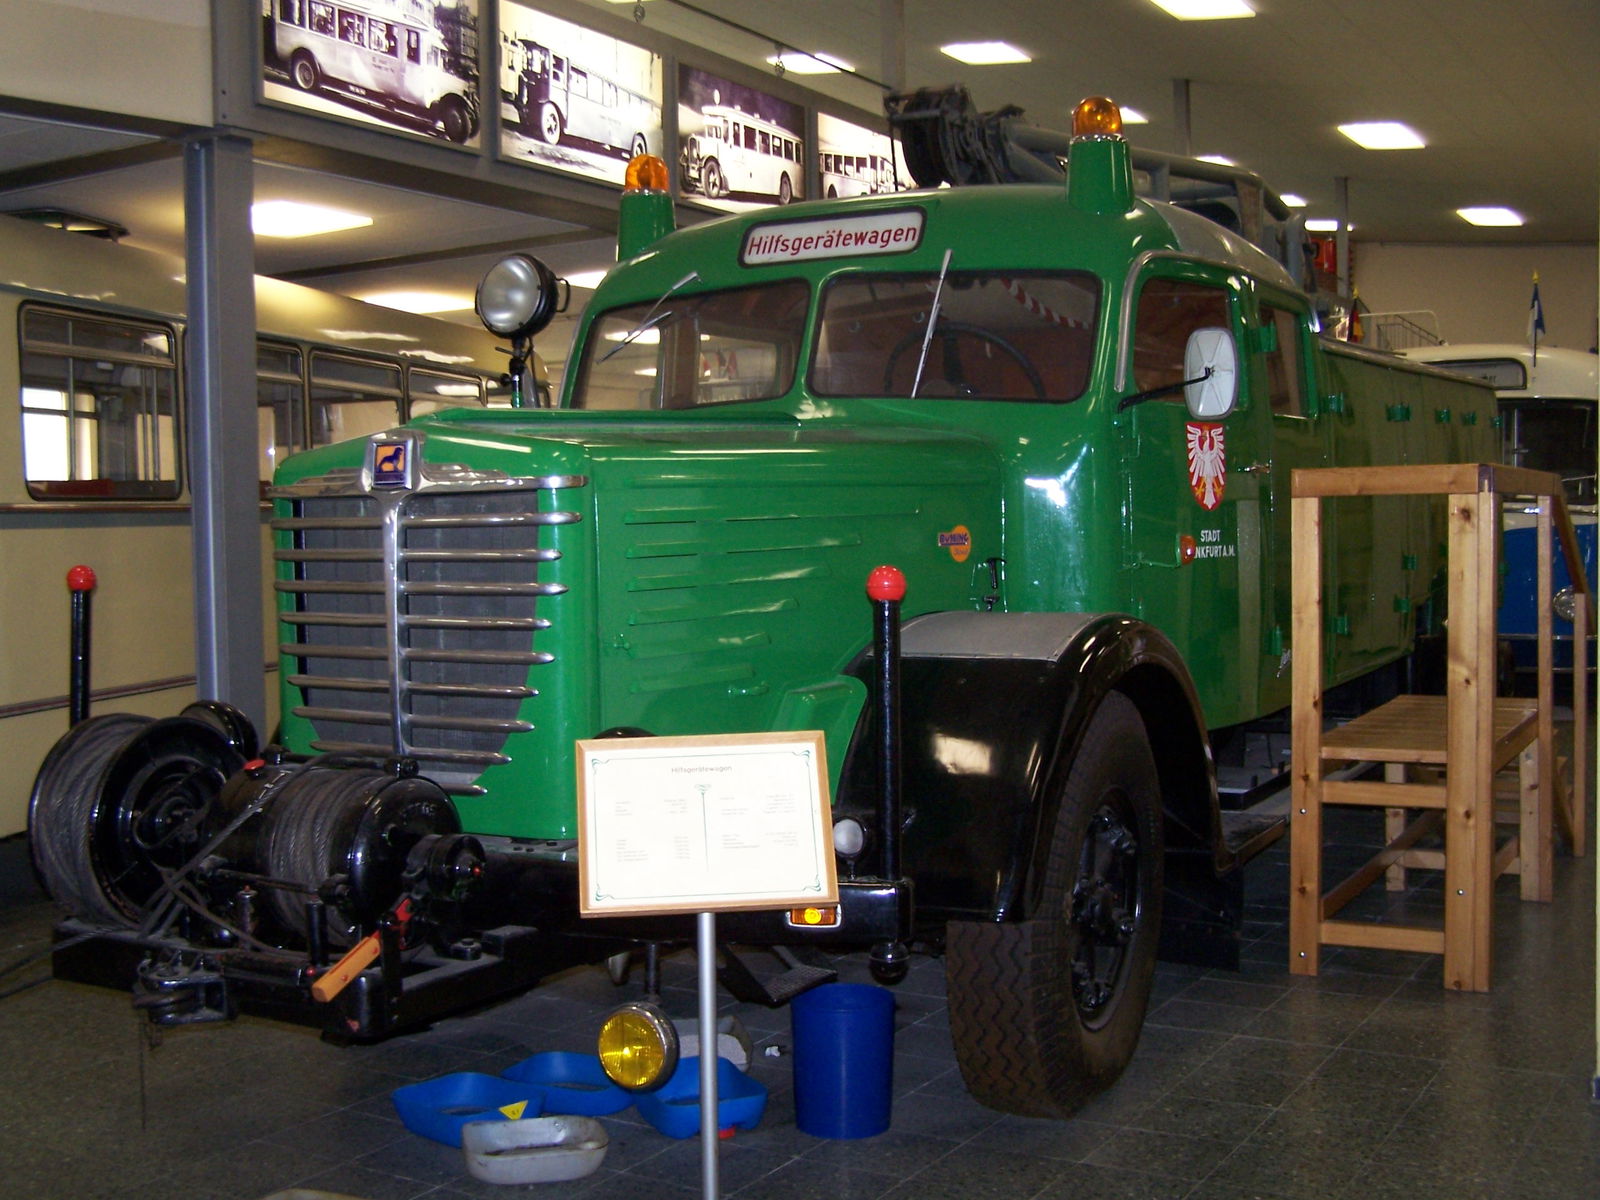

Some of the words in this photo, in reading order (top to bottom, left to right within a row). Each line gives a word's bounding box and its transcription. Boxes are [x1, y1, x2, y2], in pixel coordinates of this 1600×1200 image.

[748, 226, 917, 257] Hilfsgerätewagen
[1200, 529, 1221, 543] STADT
[1194, 545, 1222, 559] NKFURT
